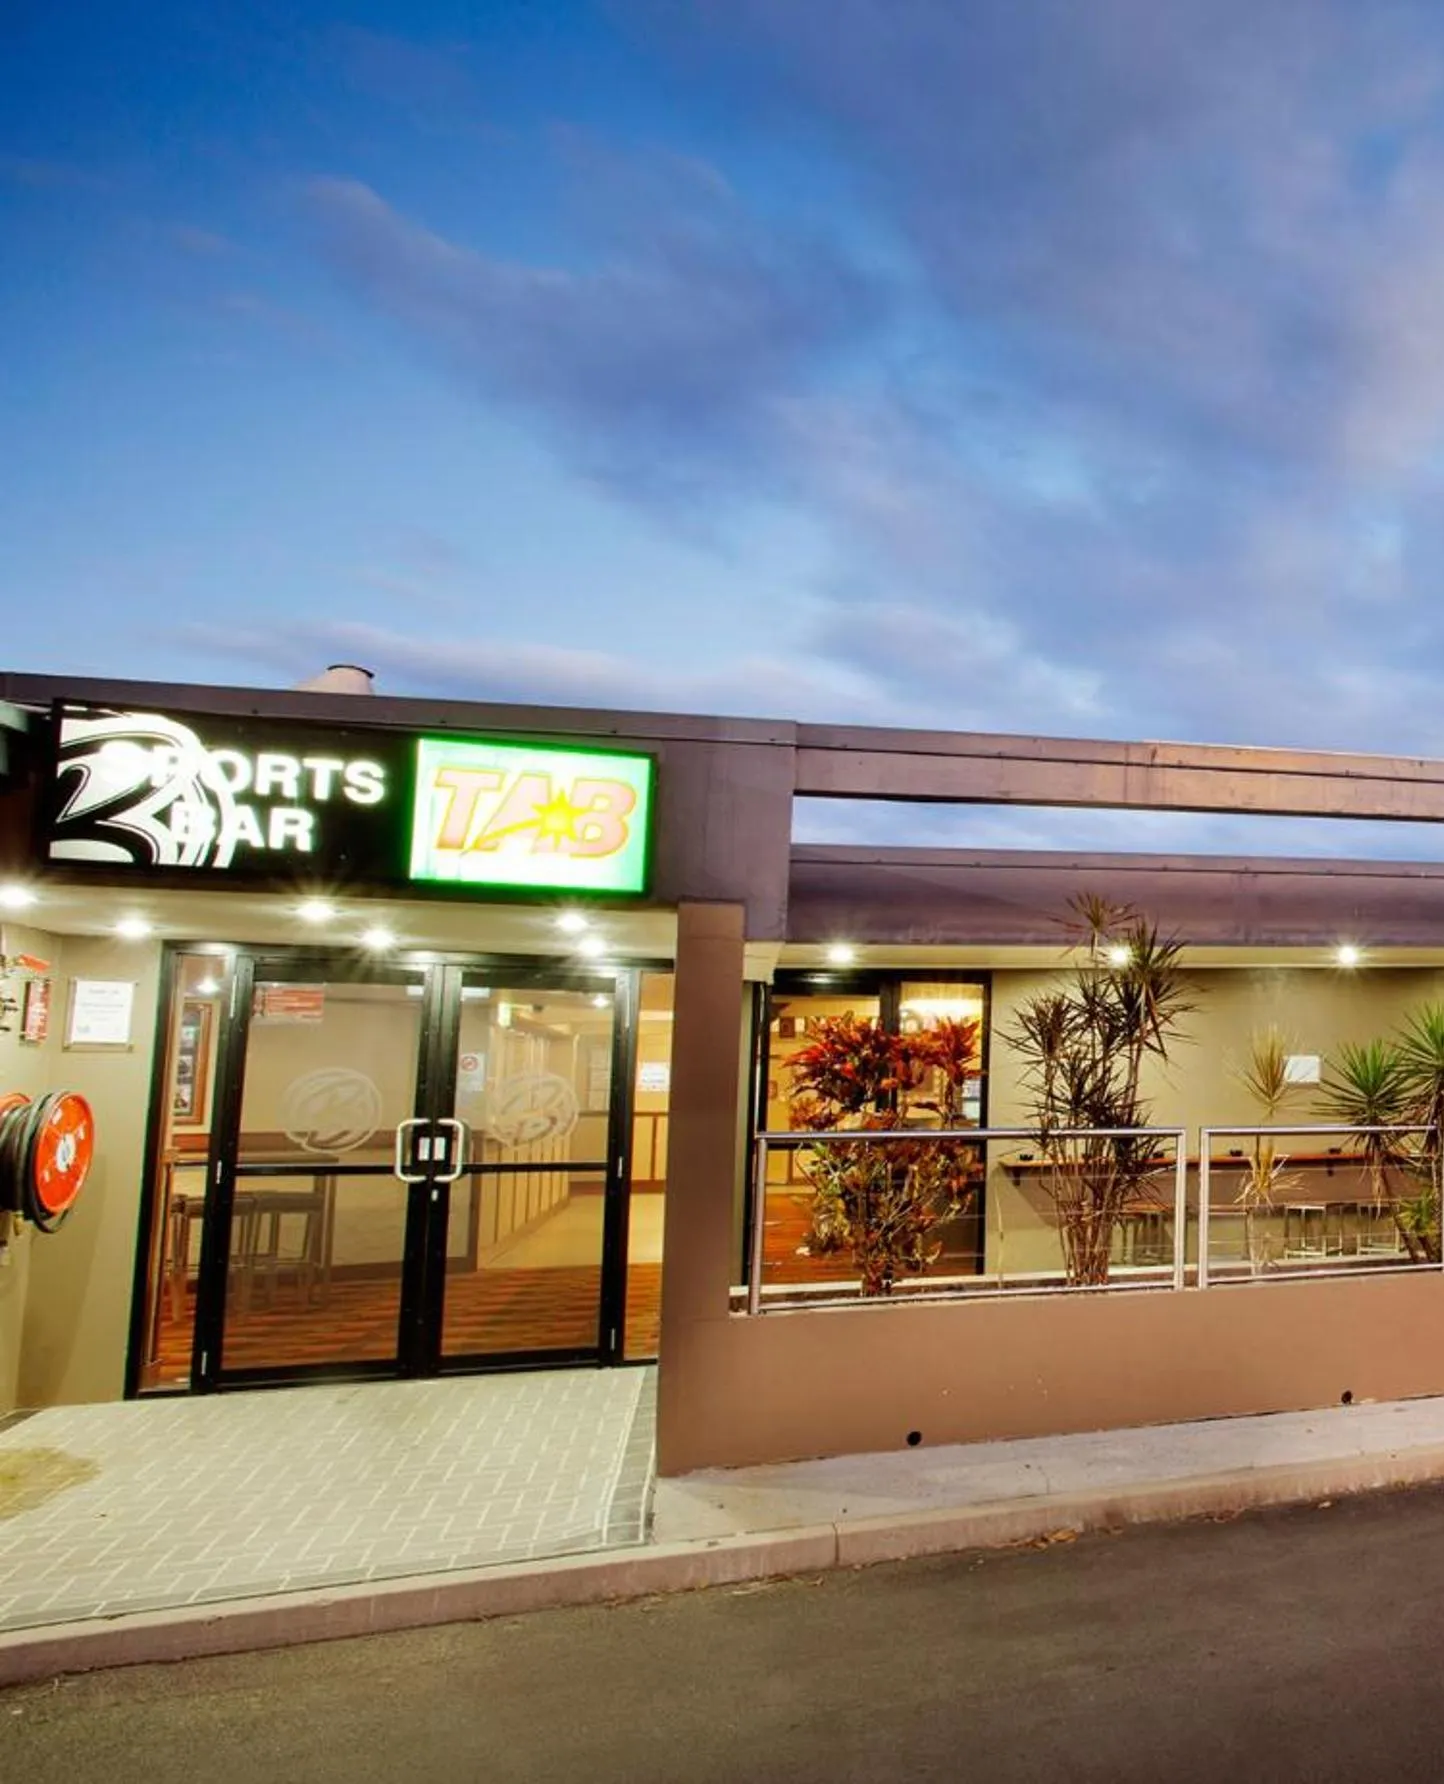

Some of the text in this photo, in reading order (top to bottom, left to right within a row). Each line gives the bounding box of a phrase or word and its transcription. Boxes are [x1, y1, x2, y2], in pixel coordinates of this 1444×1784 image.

[100, 741, 386, 804] PORTS
[171, 802, 314, 851] BAR
[434, 766, 637, 858] TAB
